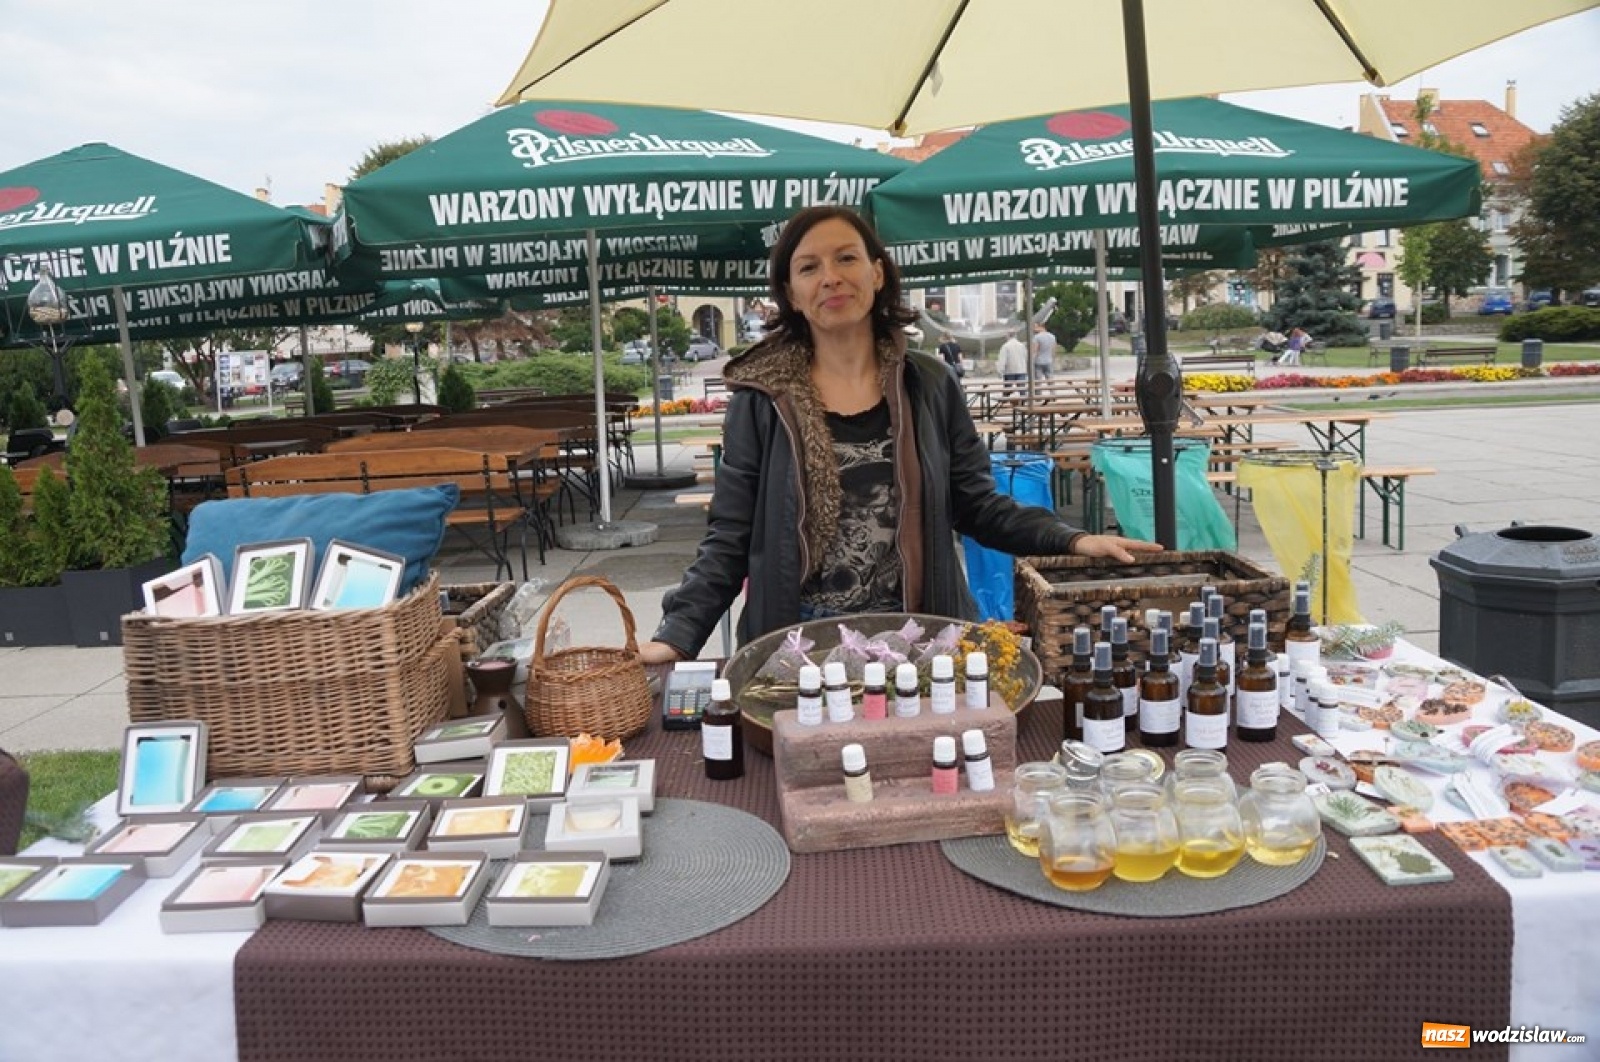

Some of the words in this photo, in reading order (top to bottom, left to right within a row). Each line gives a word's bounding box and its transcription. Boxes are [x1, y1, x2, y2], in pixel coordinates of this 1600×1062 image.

[507, 128, 641, 167] Pilsner
[1019, 138, 1135, 170] Pilsne
[429, 186, 576, 226] WARZONY
[583, 180, 743, 220] WYŁĄCZNIE
[751, 179, 777, 210] W
[943, 185, 1088, 225] WARZONY
[1095, 178, 1259, 218] WYĄCZNIE
[1267, 178, 1295, 210] W
[1304, 170, 1409, 209] PILŹNIE
[92, 245, 119, 274] W
[128, 231, 232, 271] PILŹNIE
[700, 260, 718, 280] W
[284, 300, 301, 318] W
